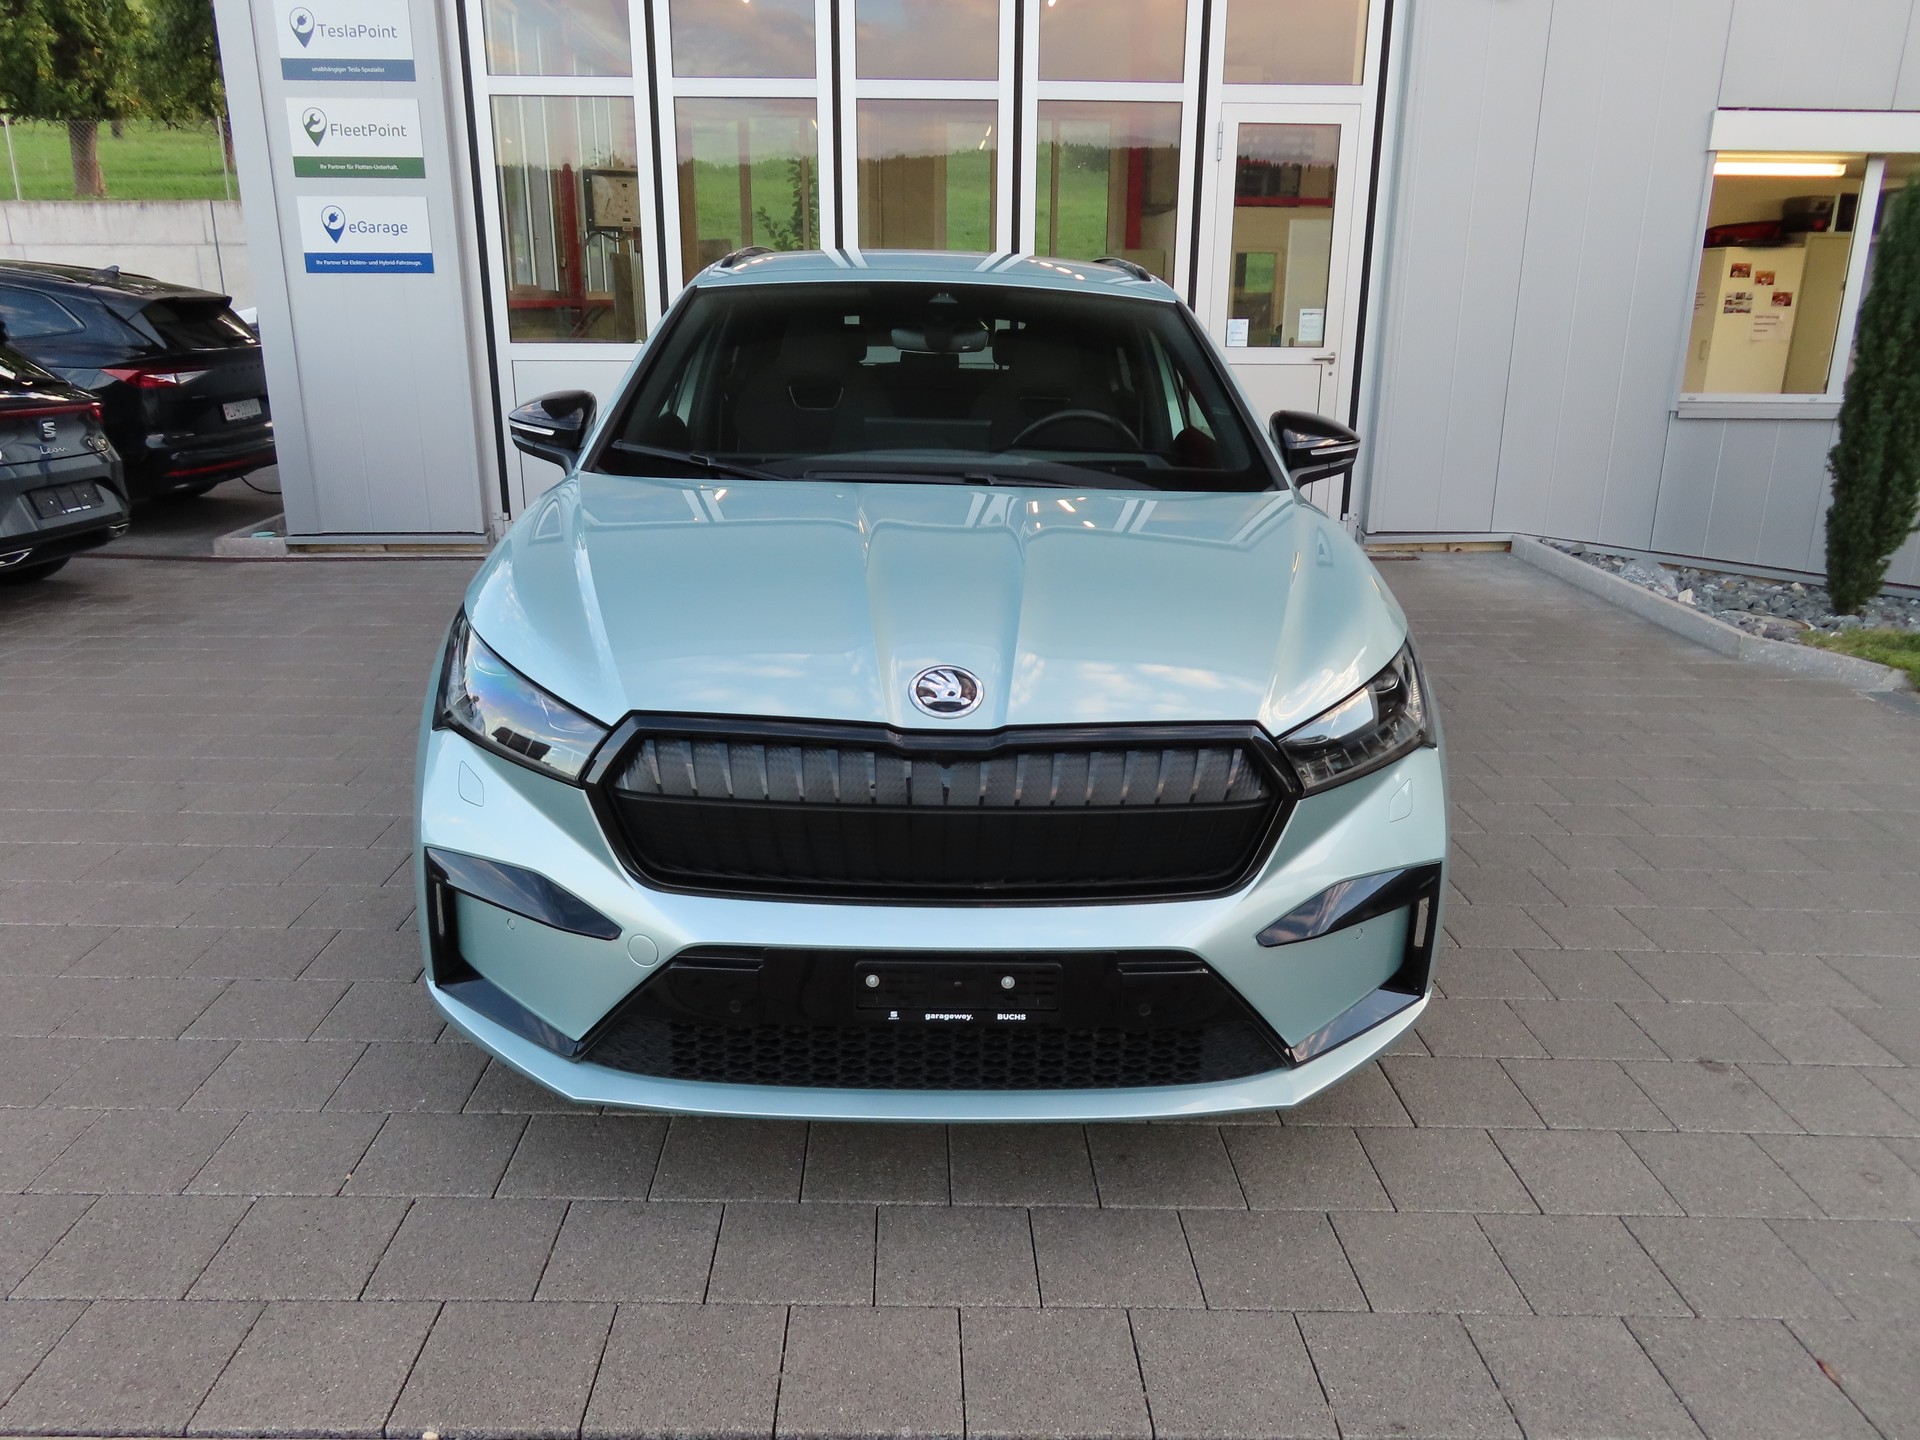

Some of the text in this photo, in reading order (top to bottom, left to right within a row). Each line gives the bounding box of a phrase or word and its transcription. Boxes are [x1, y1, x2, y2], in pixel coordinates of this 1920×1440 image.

[317, 24, 398, 38] TeslaPoint
[330, 124, 408, 137] FleetPoint
[348, 220, 409, 236] eGarage
[39, 445, 68, 455] Leon
[925, 1012, 1027, 1022] garagewey. BUCHS
